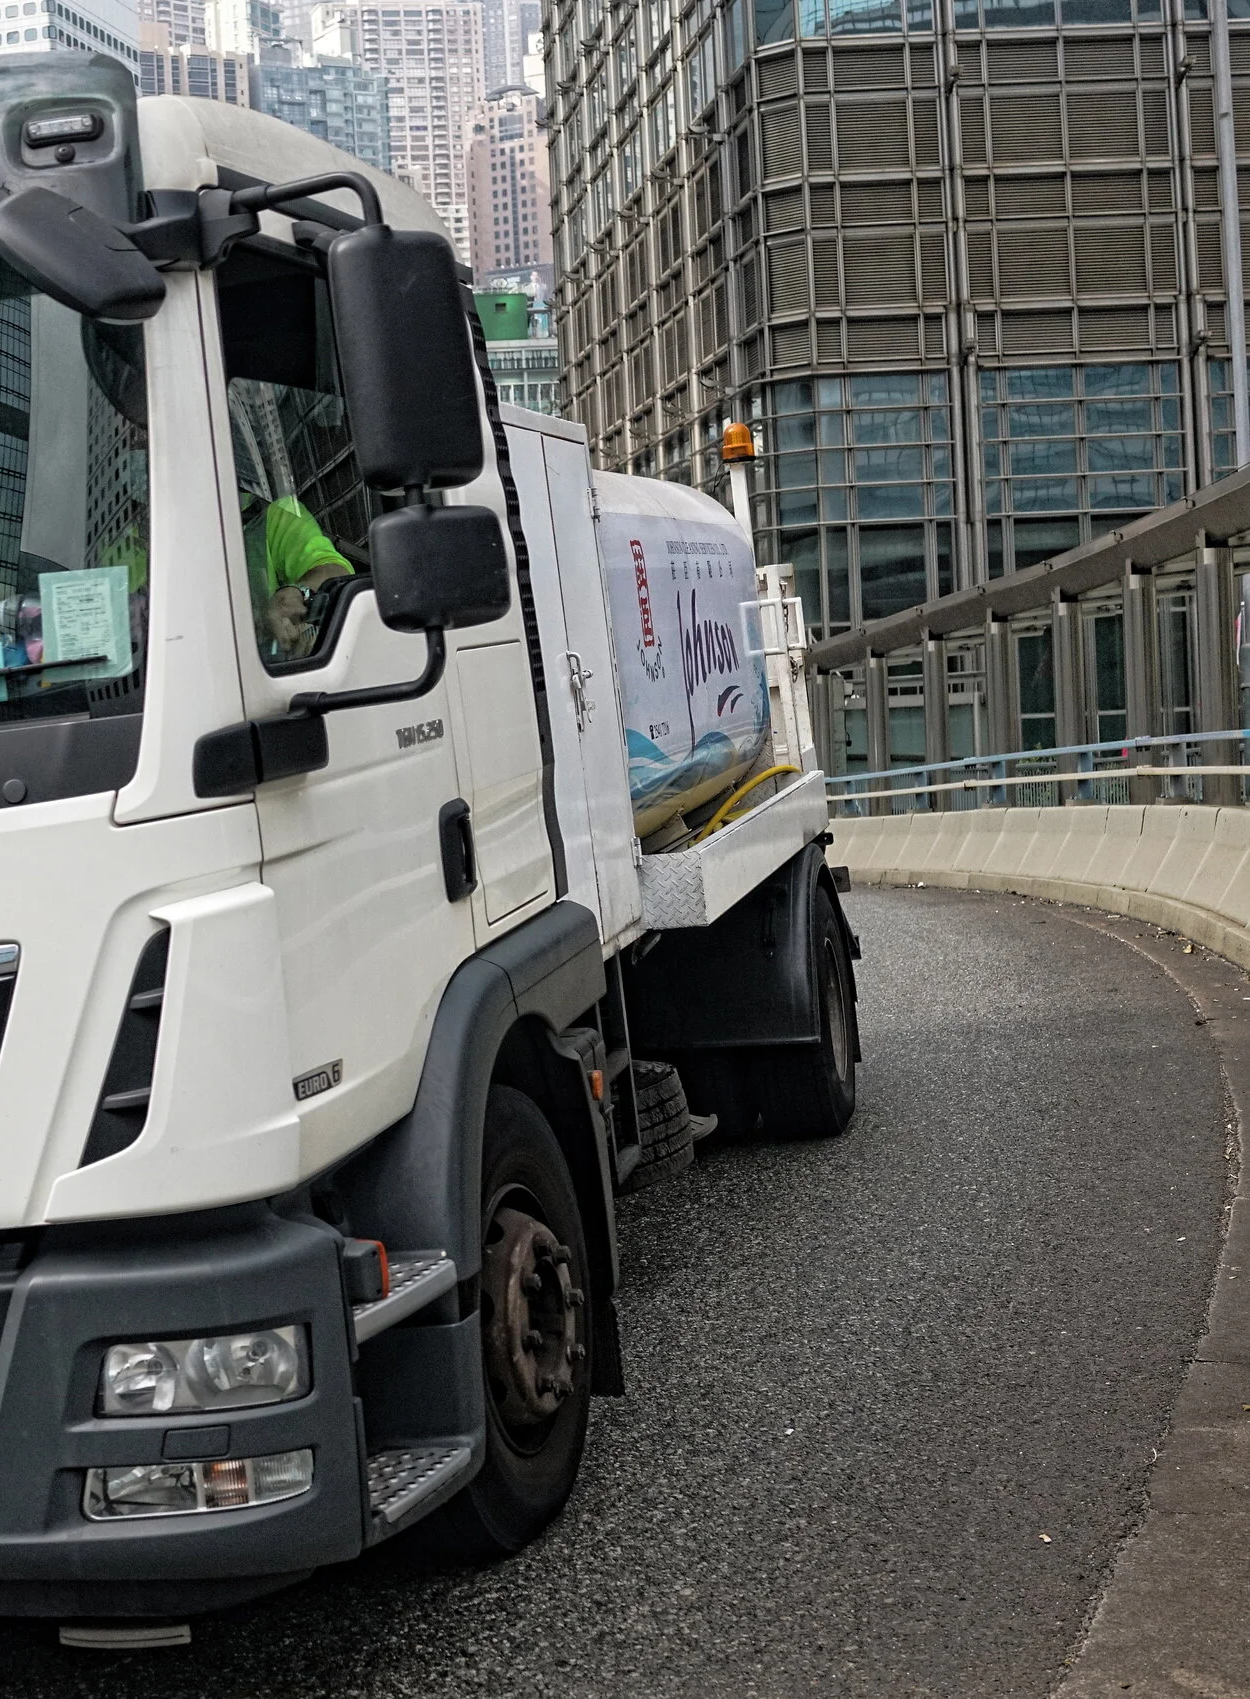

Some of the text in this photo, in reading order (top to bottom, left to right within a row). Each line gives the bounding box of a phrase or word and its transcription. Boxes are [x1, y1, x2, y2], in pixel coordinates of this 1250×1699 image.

[676, 588, 740, 756] Johnson
[297, 1062, 340, 1100] EURO 6
